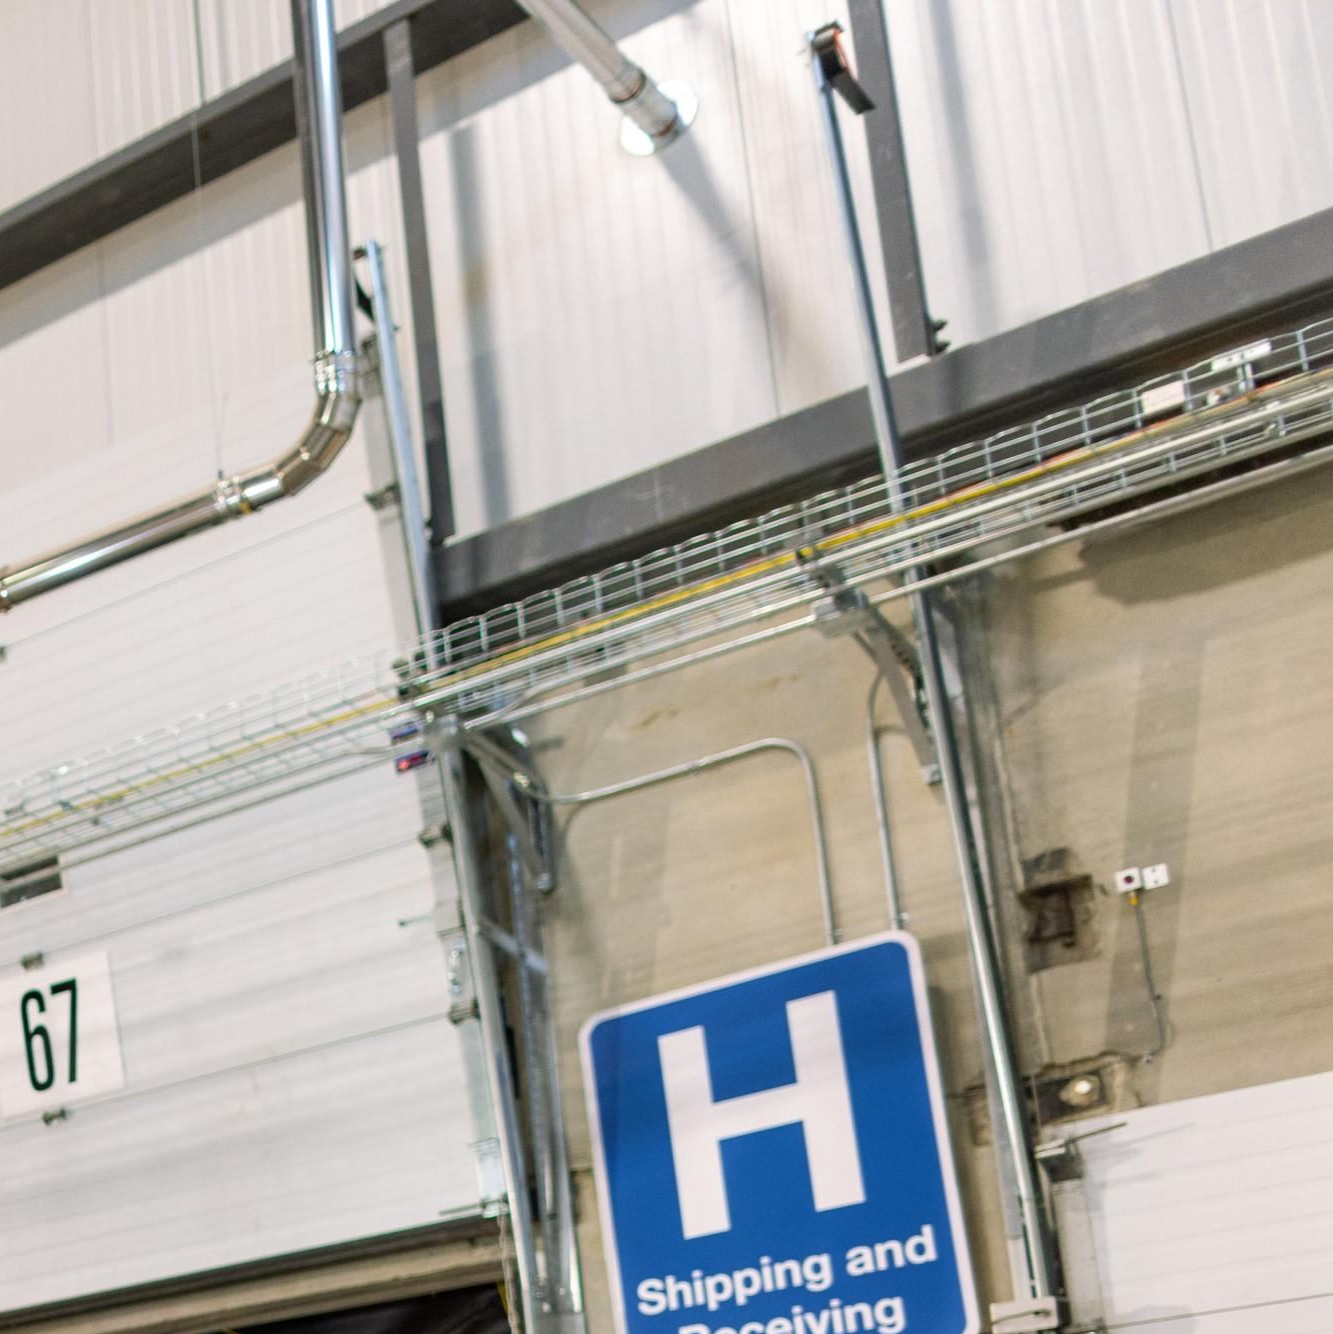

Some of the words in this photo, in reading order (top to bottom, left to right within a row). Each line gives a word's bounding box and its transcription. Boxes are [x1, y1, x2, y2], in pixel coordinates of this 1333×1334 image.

[20, 976, 78, 1092] 67
[657, 989, 867, 1240] H
[636, 1252, 834, 1316] Shipping
[846, 1224, 938, 1277] and
